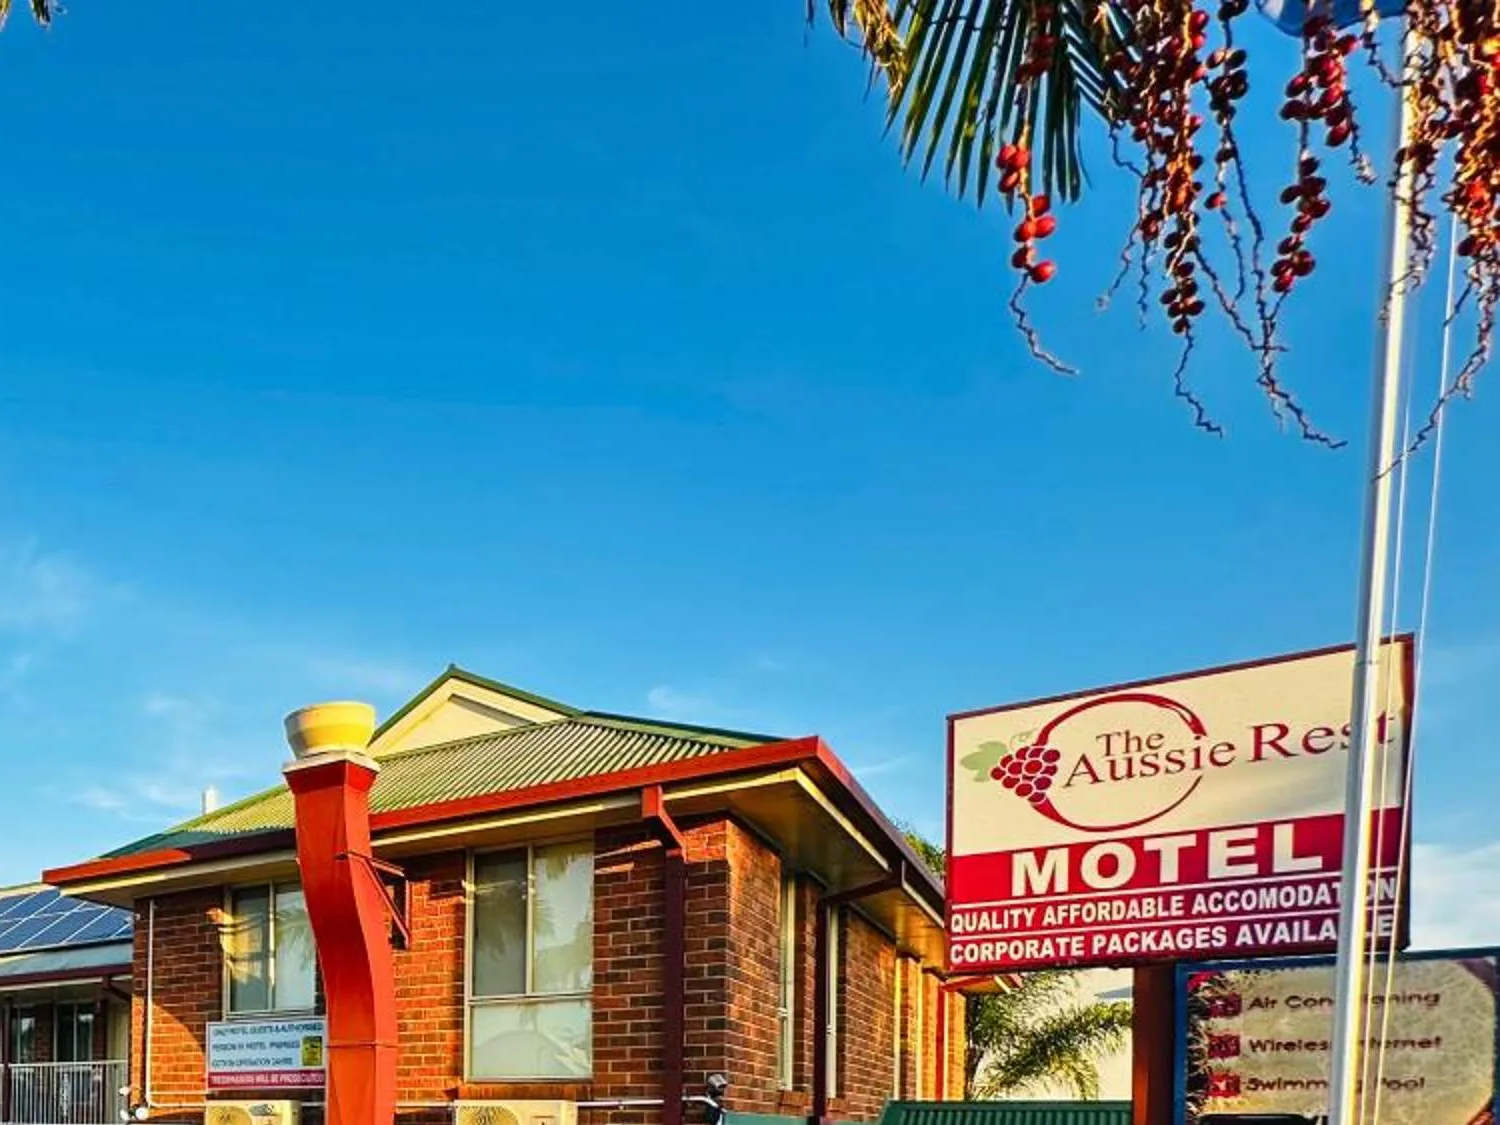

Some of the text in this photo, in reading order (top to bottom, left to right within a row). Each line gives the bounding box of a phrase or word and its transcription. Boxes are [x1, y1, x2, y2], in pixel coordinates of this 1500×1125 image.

[1062, 734, 1236, 788] Aussie
[1096, 730, 1165, 757] The
[1010, 822, 1323, 897] MOTEL
[951, 877, 1397, 933] QUALITY AFFORDABLE ACCOMODATON
[950, 912, 1395, 964] CORPORATE PACKAGES AVAILAE
[1248, 996, 1279, 1010] Air
[1249, 1037, 1334, 1053] Wireles
